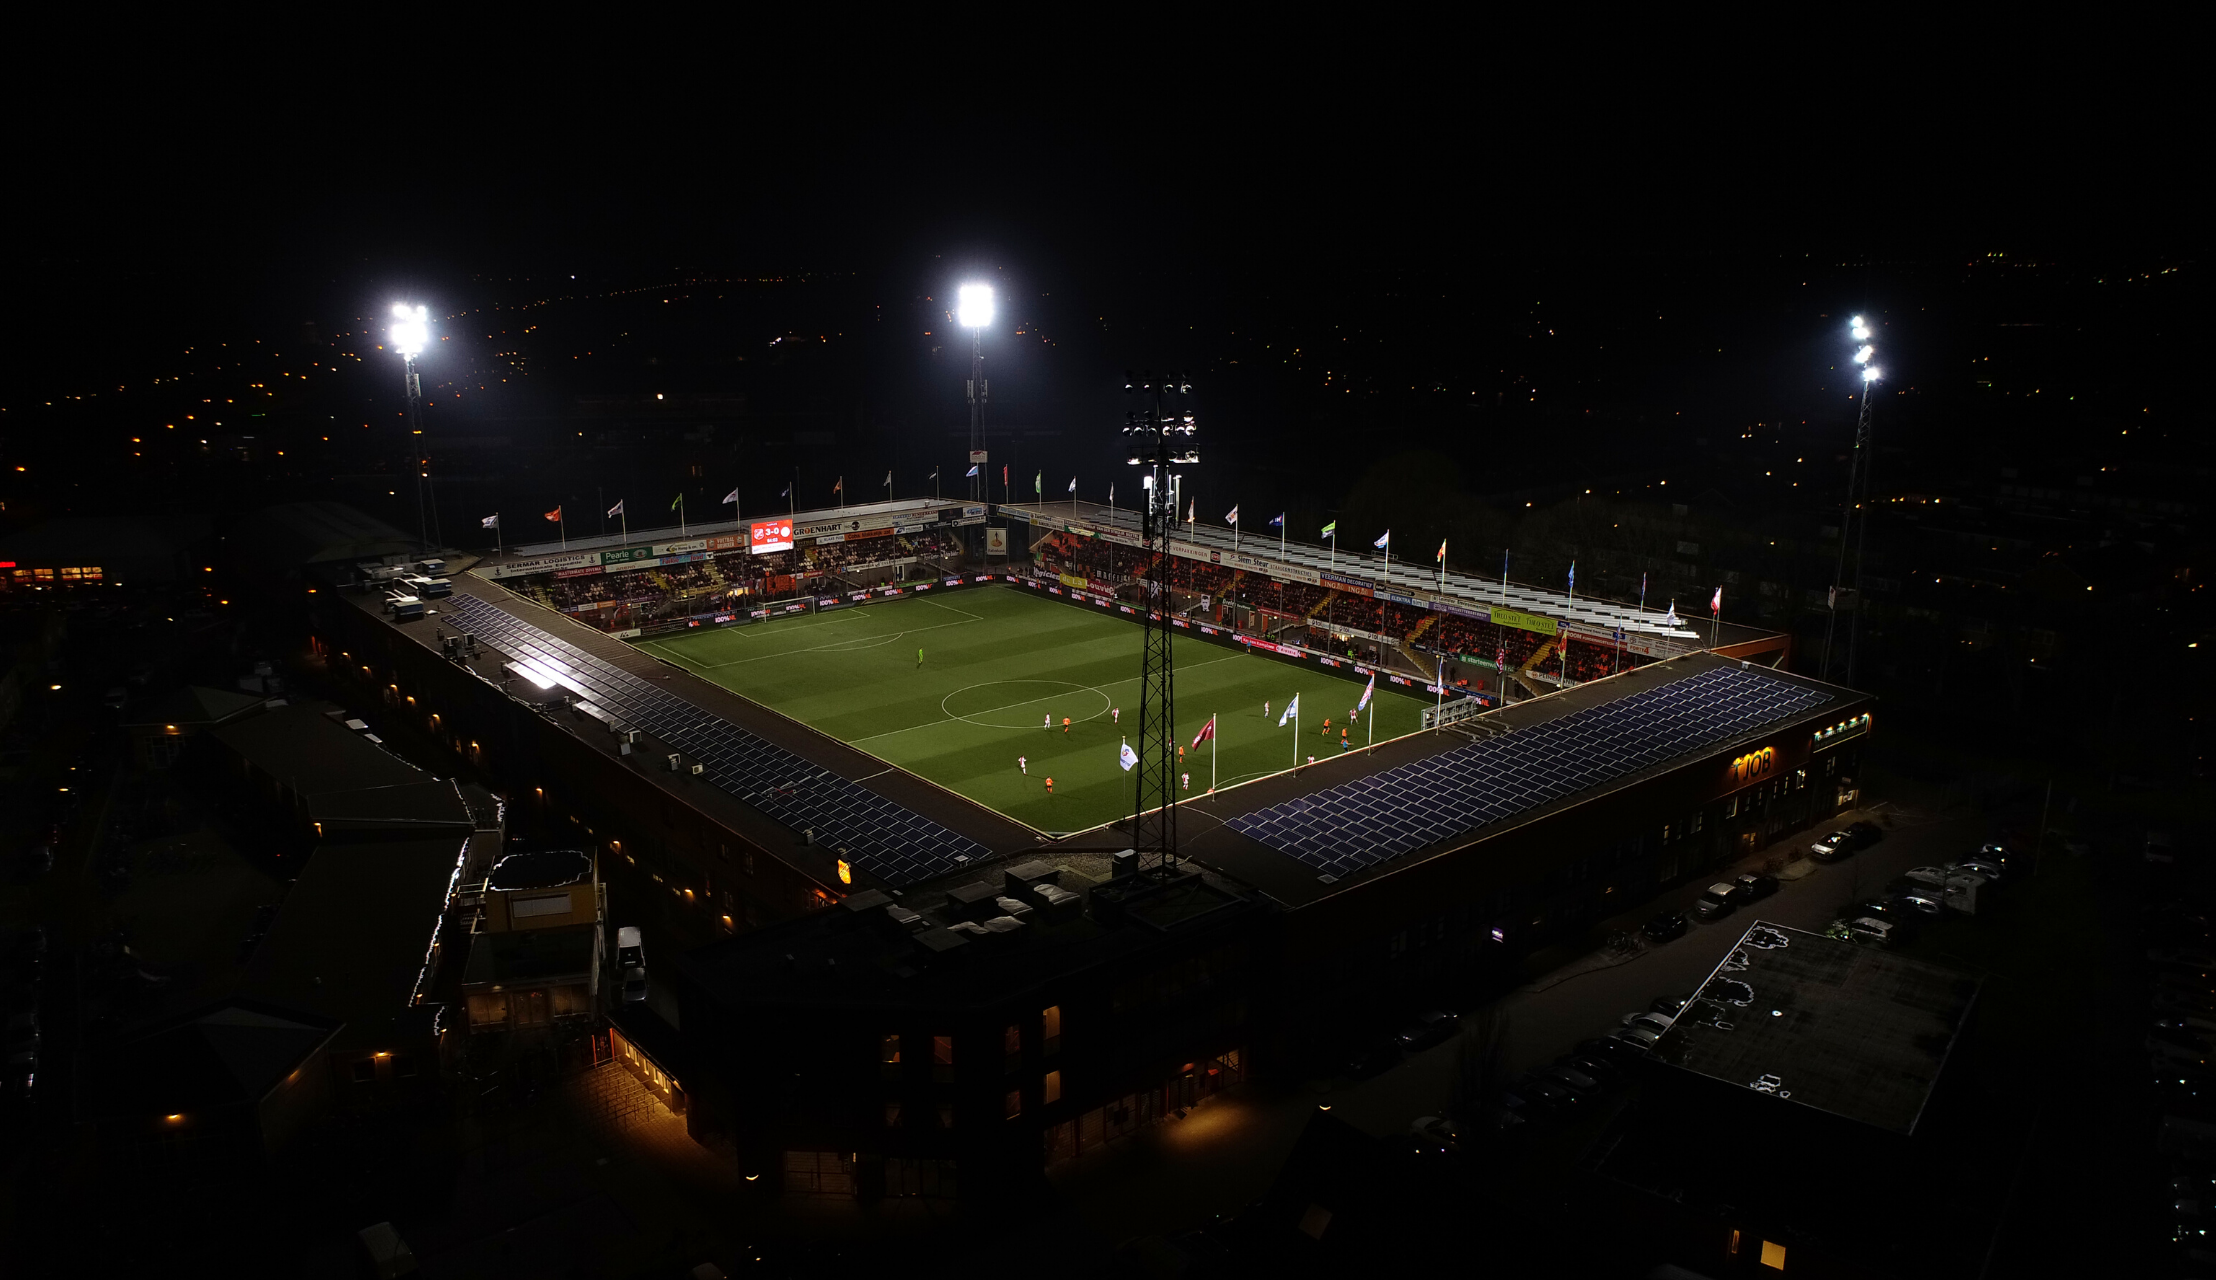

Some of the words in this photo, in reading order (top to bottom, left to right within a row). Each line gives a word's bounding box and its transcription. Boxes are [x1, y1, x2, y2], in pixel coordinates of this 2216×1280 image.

[765, 527, 779, 536] 3-0
[794, 523, 842, 536] GROENHART
[605, 550, 629, 560] Pearle
[1173, 546, 1208, 558] VERPAKKINGEN
[506, 560, 540, 569] SERMAR
[544, 555, 585, 565] LOGISTICS
[1253, 558, 1269, 568] Steur
[1072, 577, 1083, 586] La
[1321, 573, 1346, 583] VEERMAN
[1347, 578, 1373, 588] DECORATIEF
[885, 588, 903, 596] 100%NL
[1324, 581, 1336, 589] ING
[1348, 586, 1360, 594] ING
[820, 598, 839, 606] 100%NL
[1391, 595, 1411, 604] ELEKTRA
[715, 615, 736, 623] 100%NL
[1494, 611, 1508, 619] THEO
[1526, 619, 1541, 627] THEO
[1201, 627, 1219, 636] 100%NL
[1320, 657, 1341, 668] 100%NL
[1354, 666, 1375, 677] 100%NL
[1390, 675, 1412, 687] 100%NL
[1539, 673, 1575, 686] PEINEMNN
